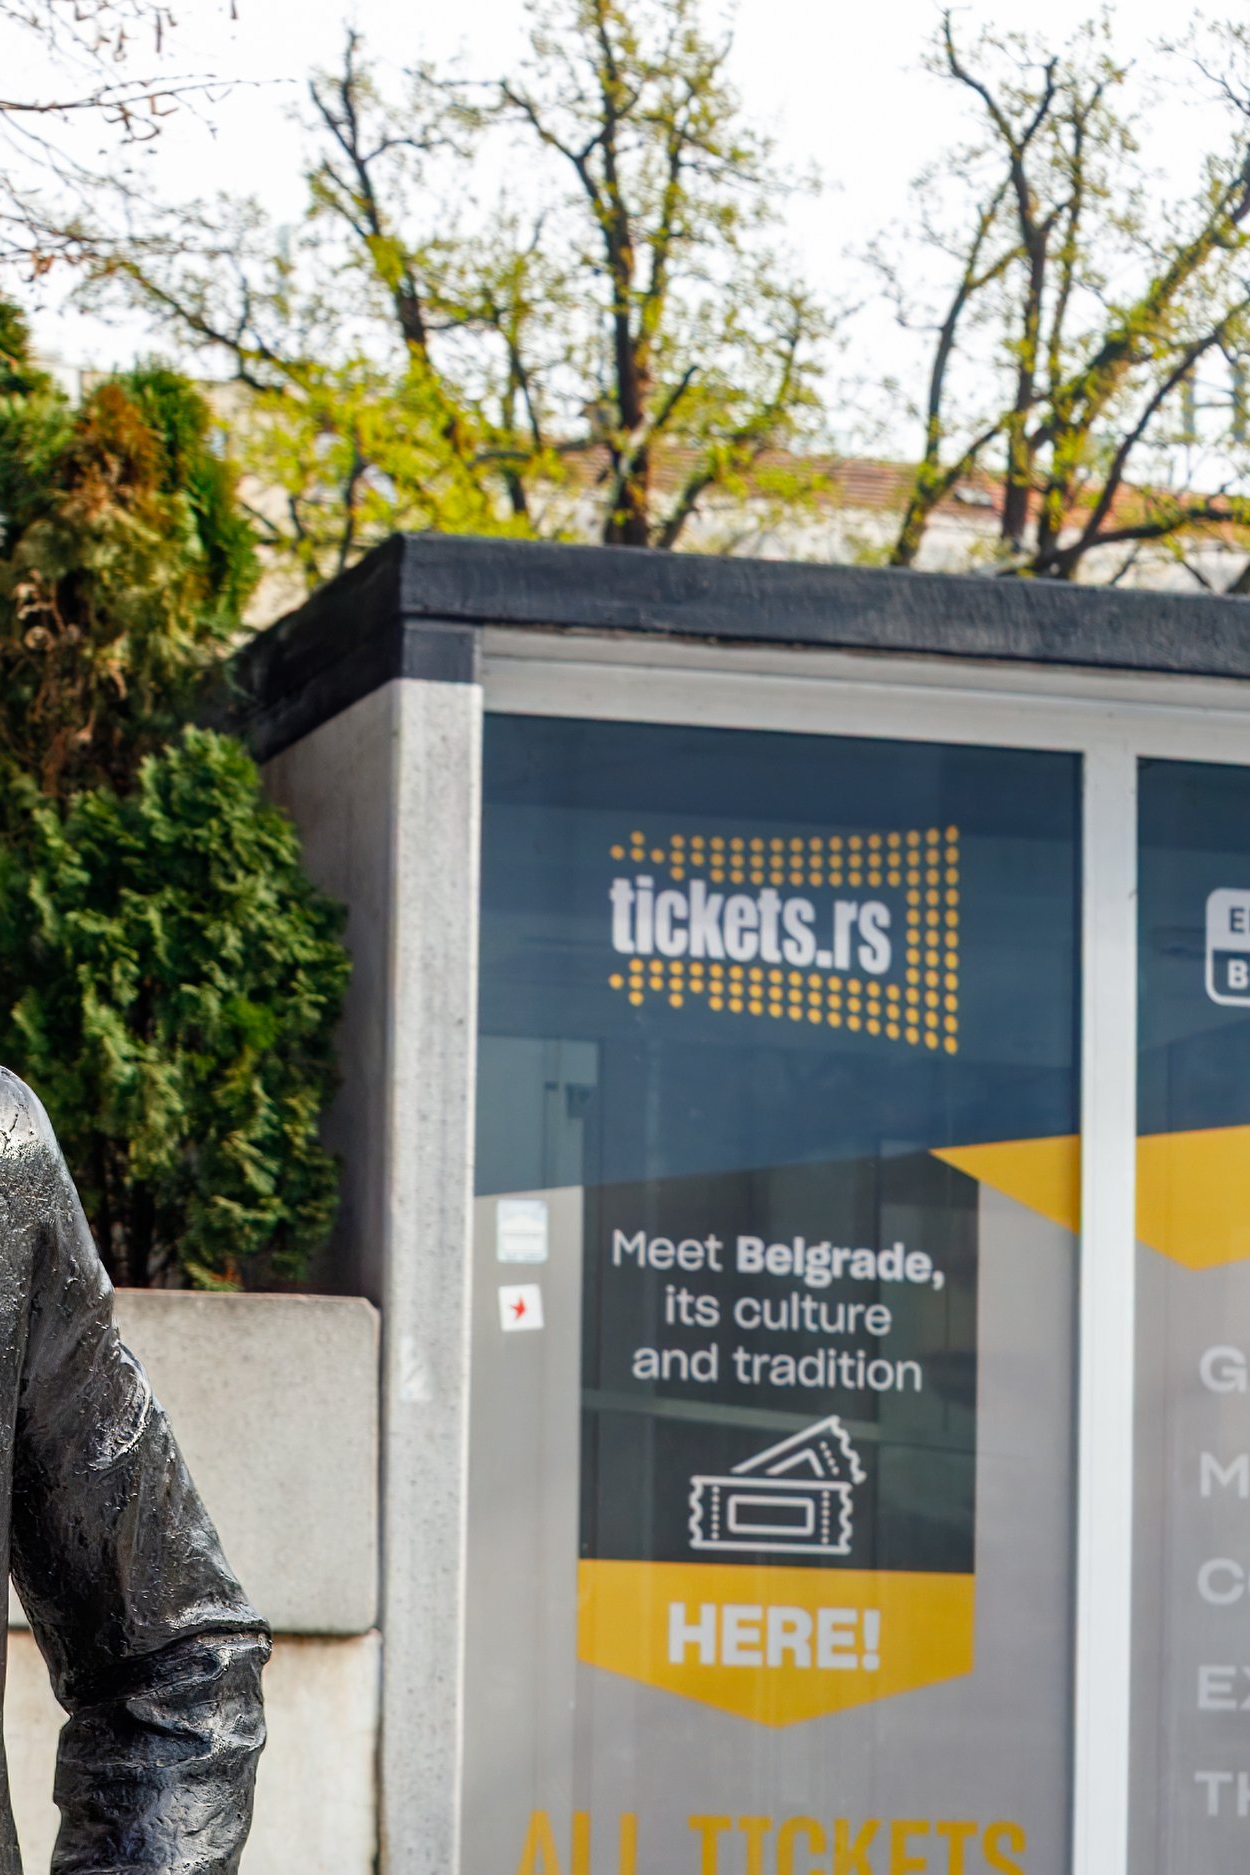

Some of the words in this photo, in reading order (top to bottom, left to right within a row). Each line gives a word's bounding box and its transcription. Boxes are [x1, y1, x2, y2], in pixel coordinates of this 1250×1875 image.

[609, 874, 892, 974] tickets.rs
[612, 1229, 723, 1272] Meet
[736, 1235, 945, 1290] Belgrade,
[665, 1284, 721, 1327] its
[734, 1291, 892, 1336] culture
[631, 1343, 719, 1383] and
[731, 1345, 922, 1392] tradition
[667, 1601, 881, 1672] HERE!
